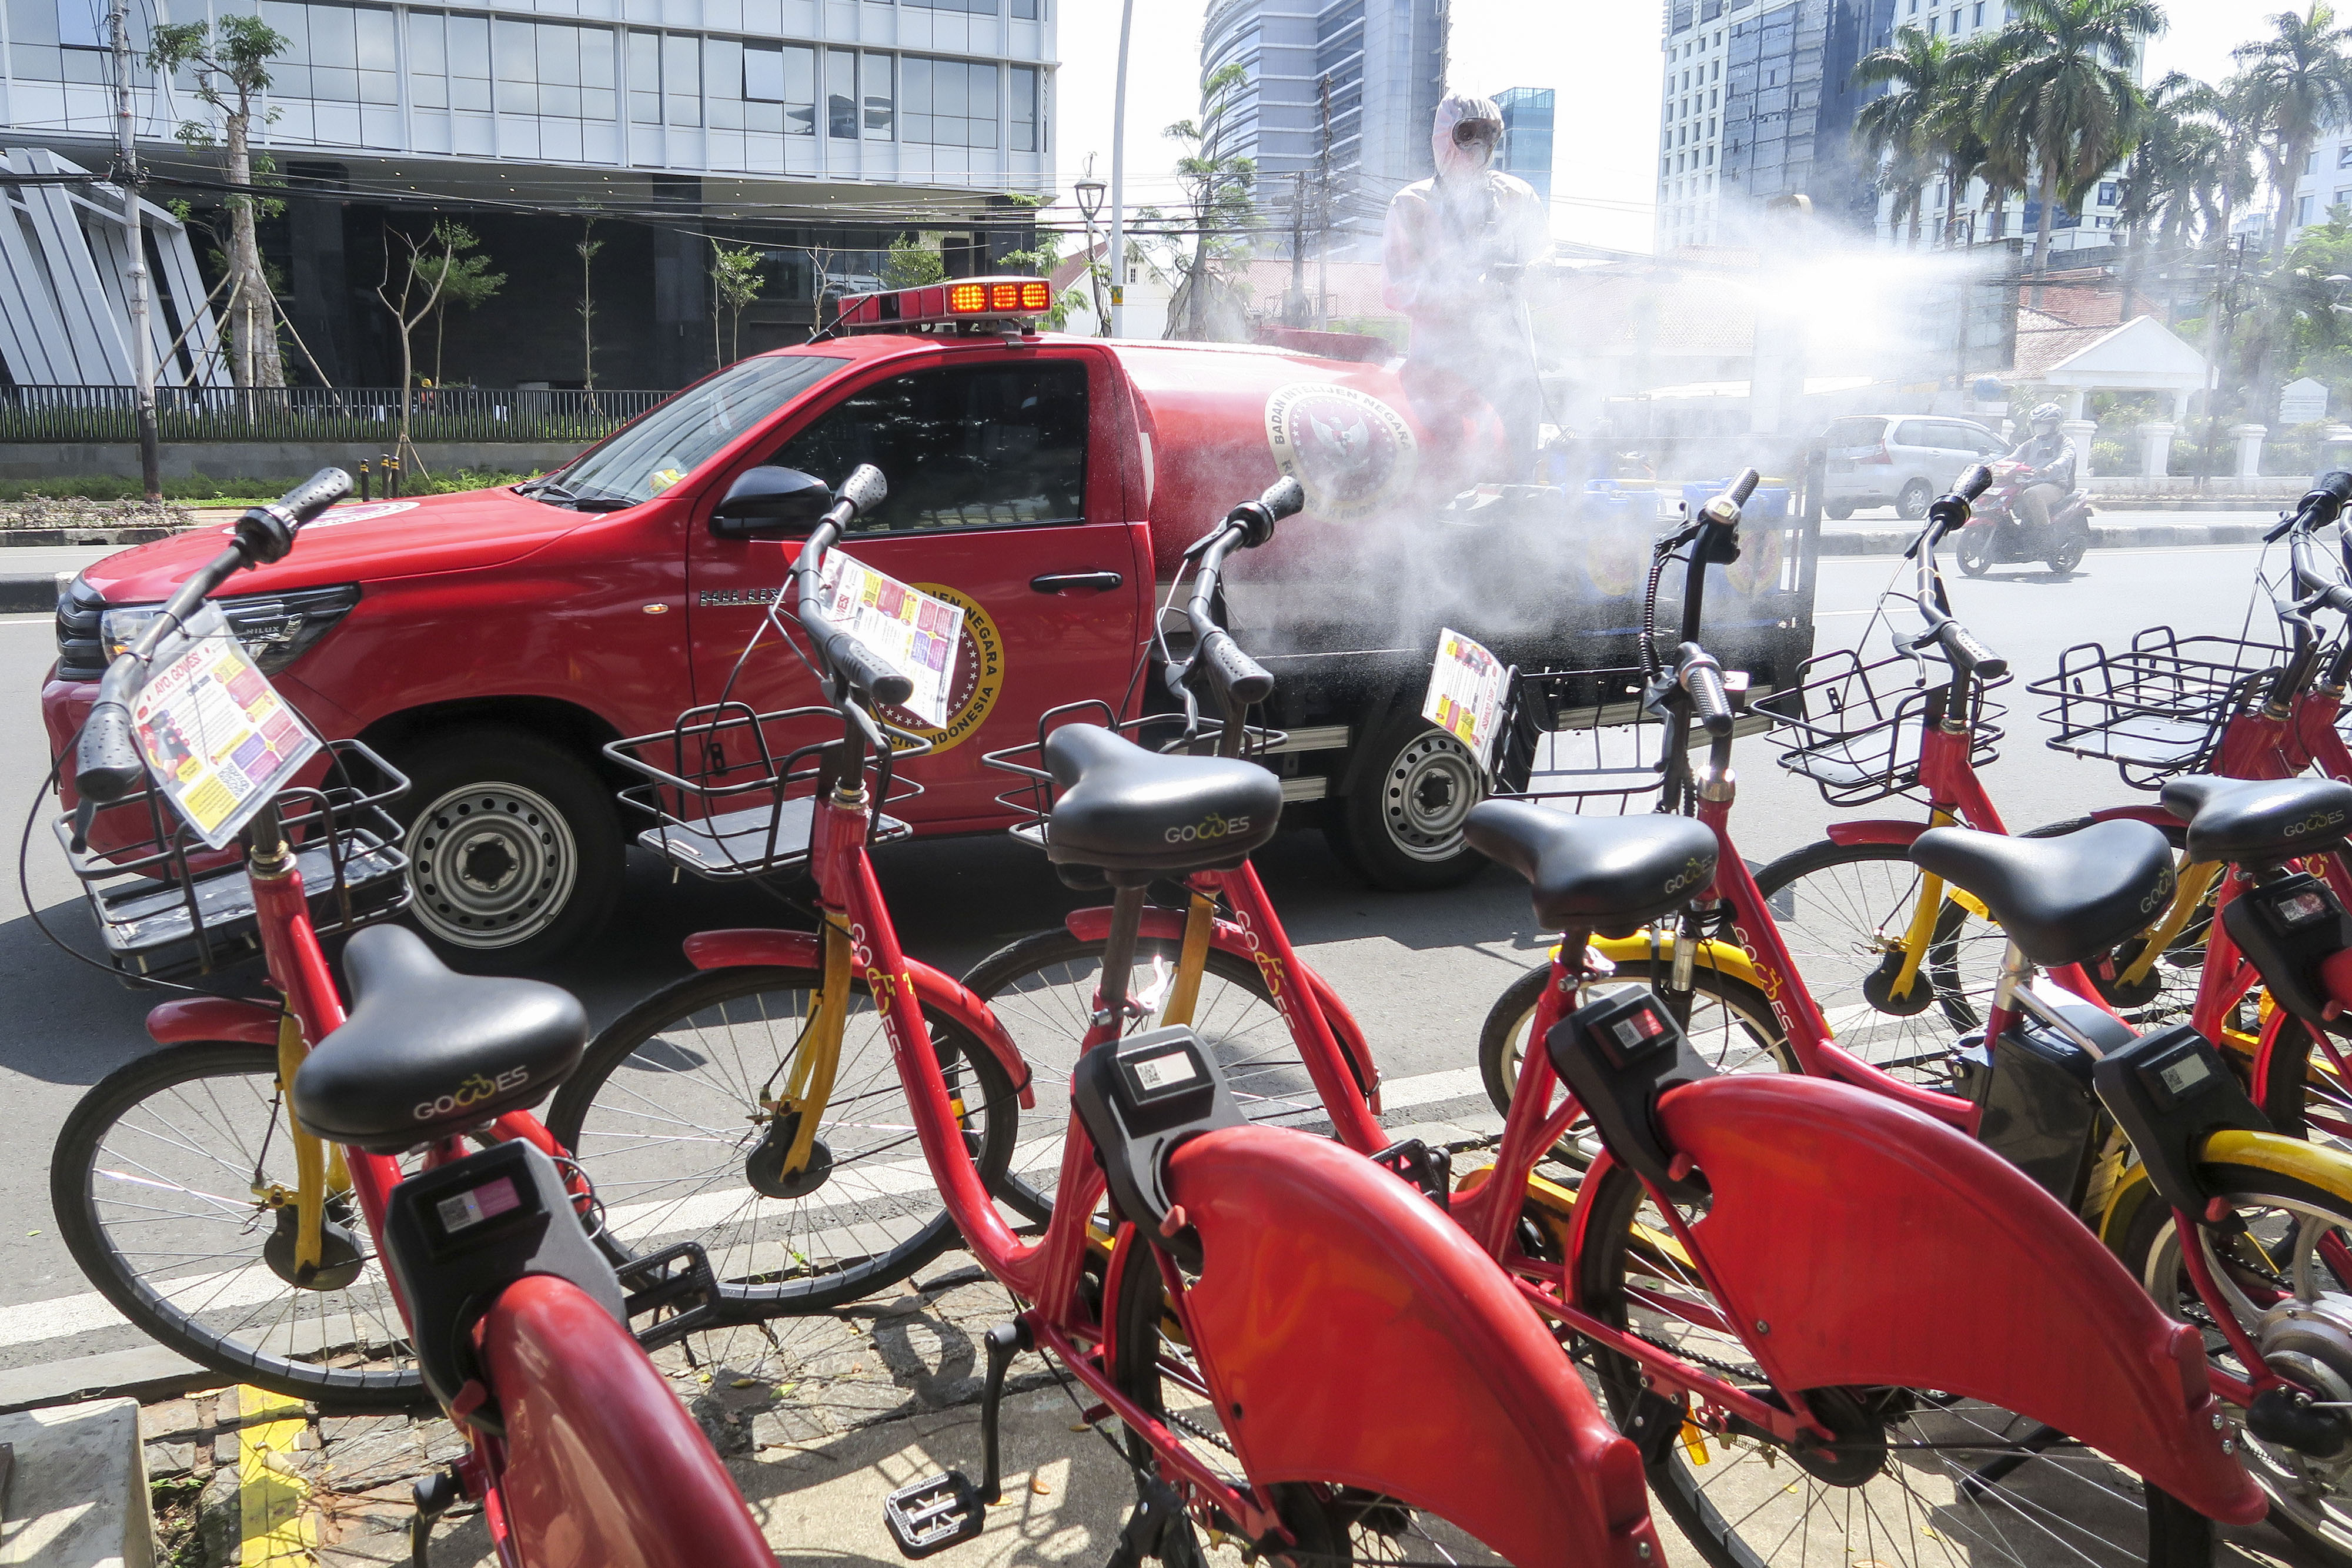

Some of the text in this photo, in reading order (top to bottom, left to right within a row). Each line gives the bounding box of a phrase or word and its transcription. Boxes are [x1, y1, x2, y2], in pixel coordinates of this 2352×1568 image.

[1271, 385, 1412, 450] BADAN INTELIJEN NEGARA
[701, 589, 786, 606] HILUX
[246, 626, 279, 634] HILUX
[964, 606, 997, 676] NEGARA
[155, 676, 175, 696] AYO,
[926, 687, 994, 745] NDONESIA
